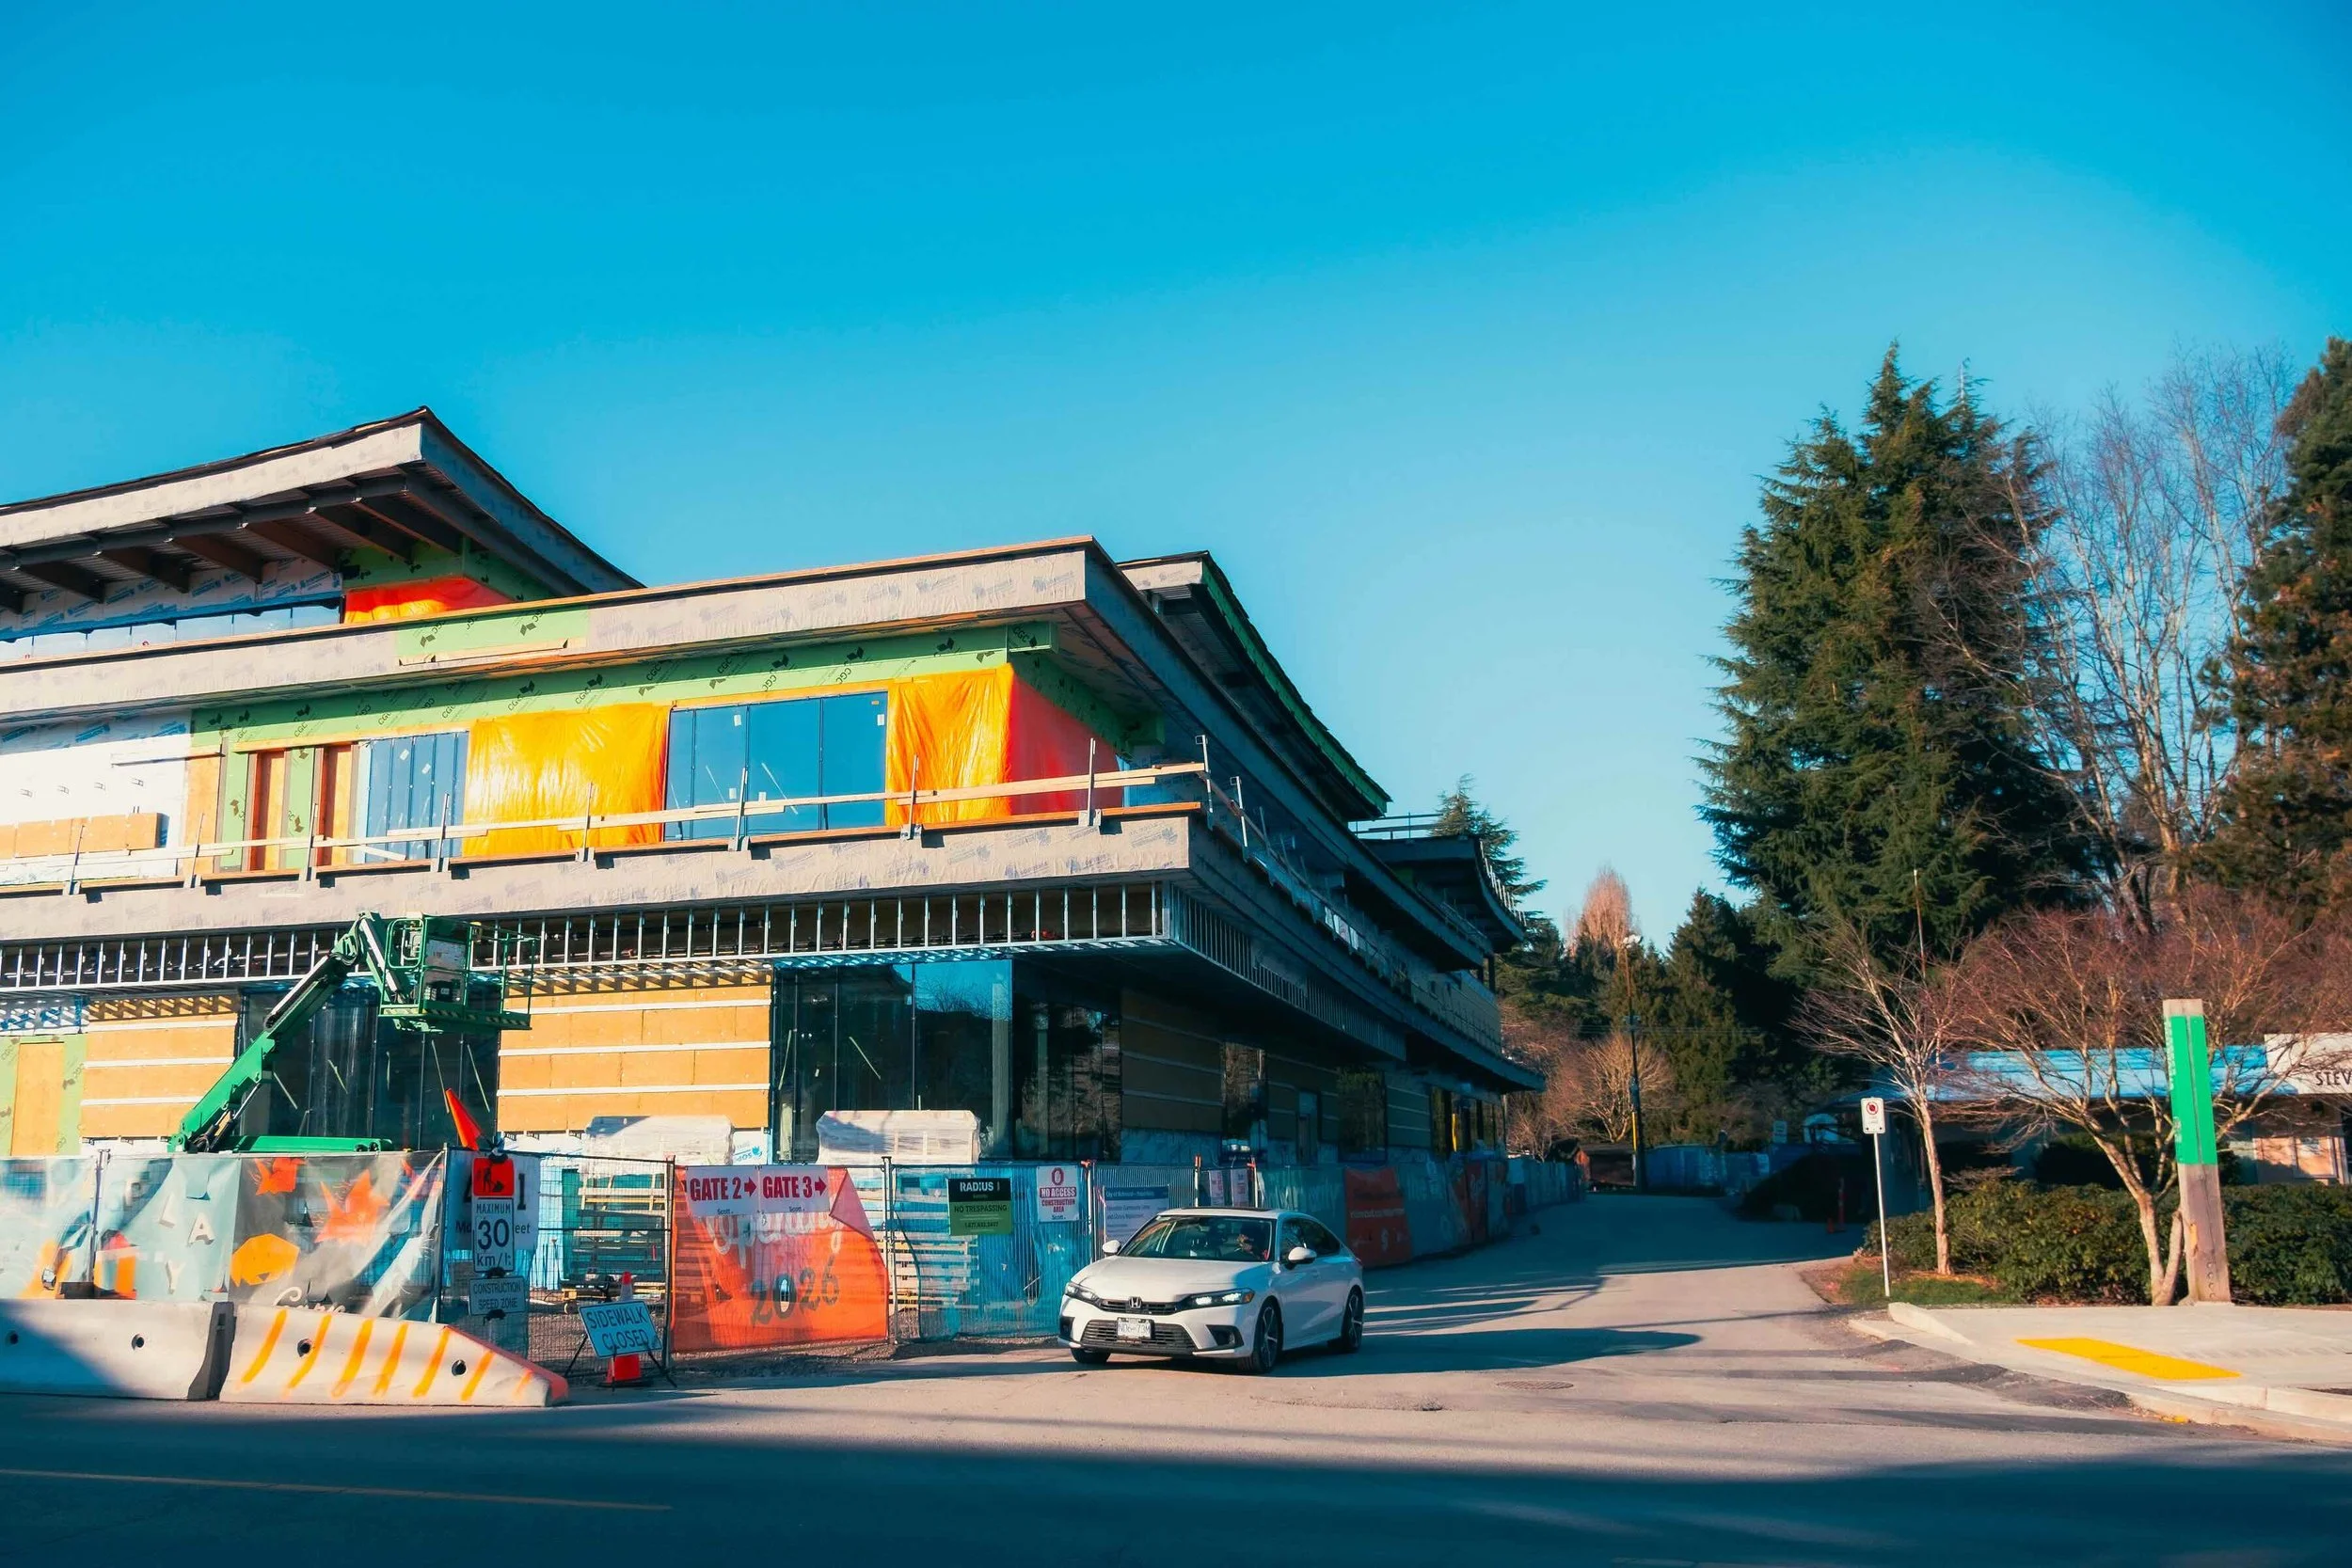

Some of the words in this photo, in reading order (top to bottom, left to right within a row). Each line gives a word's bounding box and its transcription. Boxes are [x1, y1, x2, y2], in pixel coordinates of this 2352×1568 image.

[1013, 626, 1029, 642] CGC
[646, 663, 662, 681] CGC
[717, 657, 733, 674] CGC
[2315, 1071, 2352, 1085] STEV
[690, 1177, 729, 1202] GATE
[732, 1176, 741, 1199] 2
[762, 1175, 800, 1199] GATE
[803, 1175, 813, 1198] 3
[960, 1181, 993, 1192] RADIUS
[1041, 1187, 1051, 1197] NO
[1051, 1187, 1076, 1197] ACCESS
[476, 1203, 511, 1214] MAXIMUM
[966, 1204, 1008, 1212] TRESPASSING
[478, 1218, 509, 1250] 30
[473, 1281, 521, 1294] CONSTRUCTION
[749, 1254, 841, 1324] 2026
[478, 1298, 500, 1309] SPEED
[501, 1297, 518, 1308] ZONE
[586, 1306, 648, 1329] SIDEWALK
[602, 1330, 649, 1351] CLOSED
